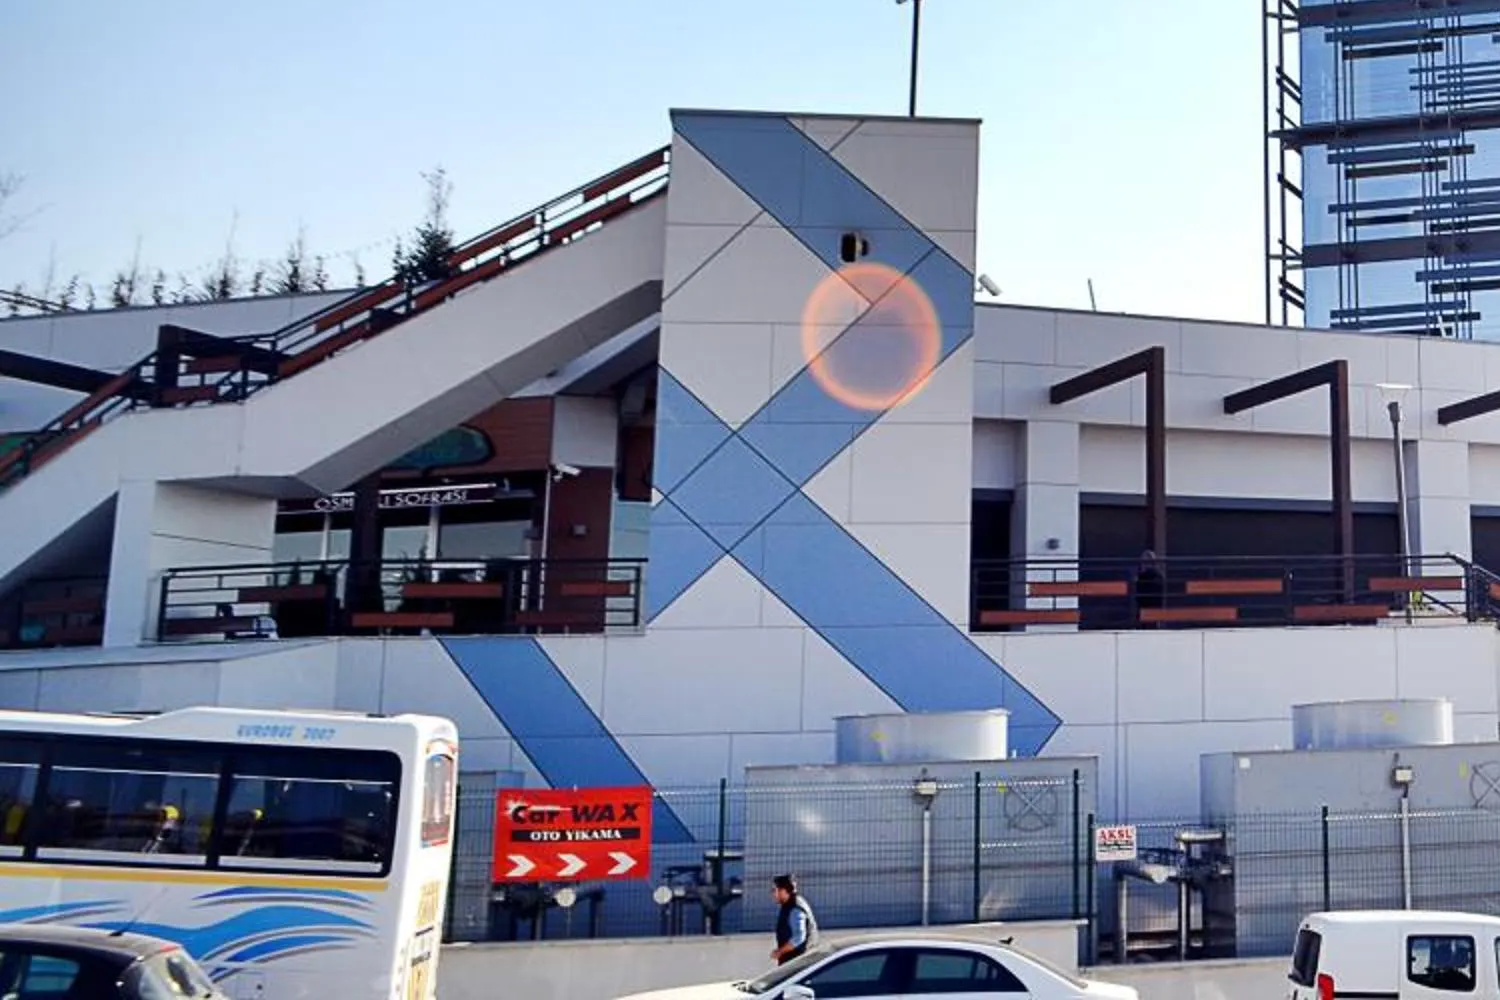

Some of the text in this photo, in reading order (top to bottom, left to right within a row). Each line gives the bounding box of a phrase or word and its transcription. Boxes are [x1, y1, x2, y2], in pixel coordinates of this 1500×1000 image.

[511, 803, 639, 825] Car WAX
[529, 829, 622, 841] OTO YIKAMA
